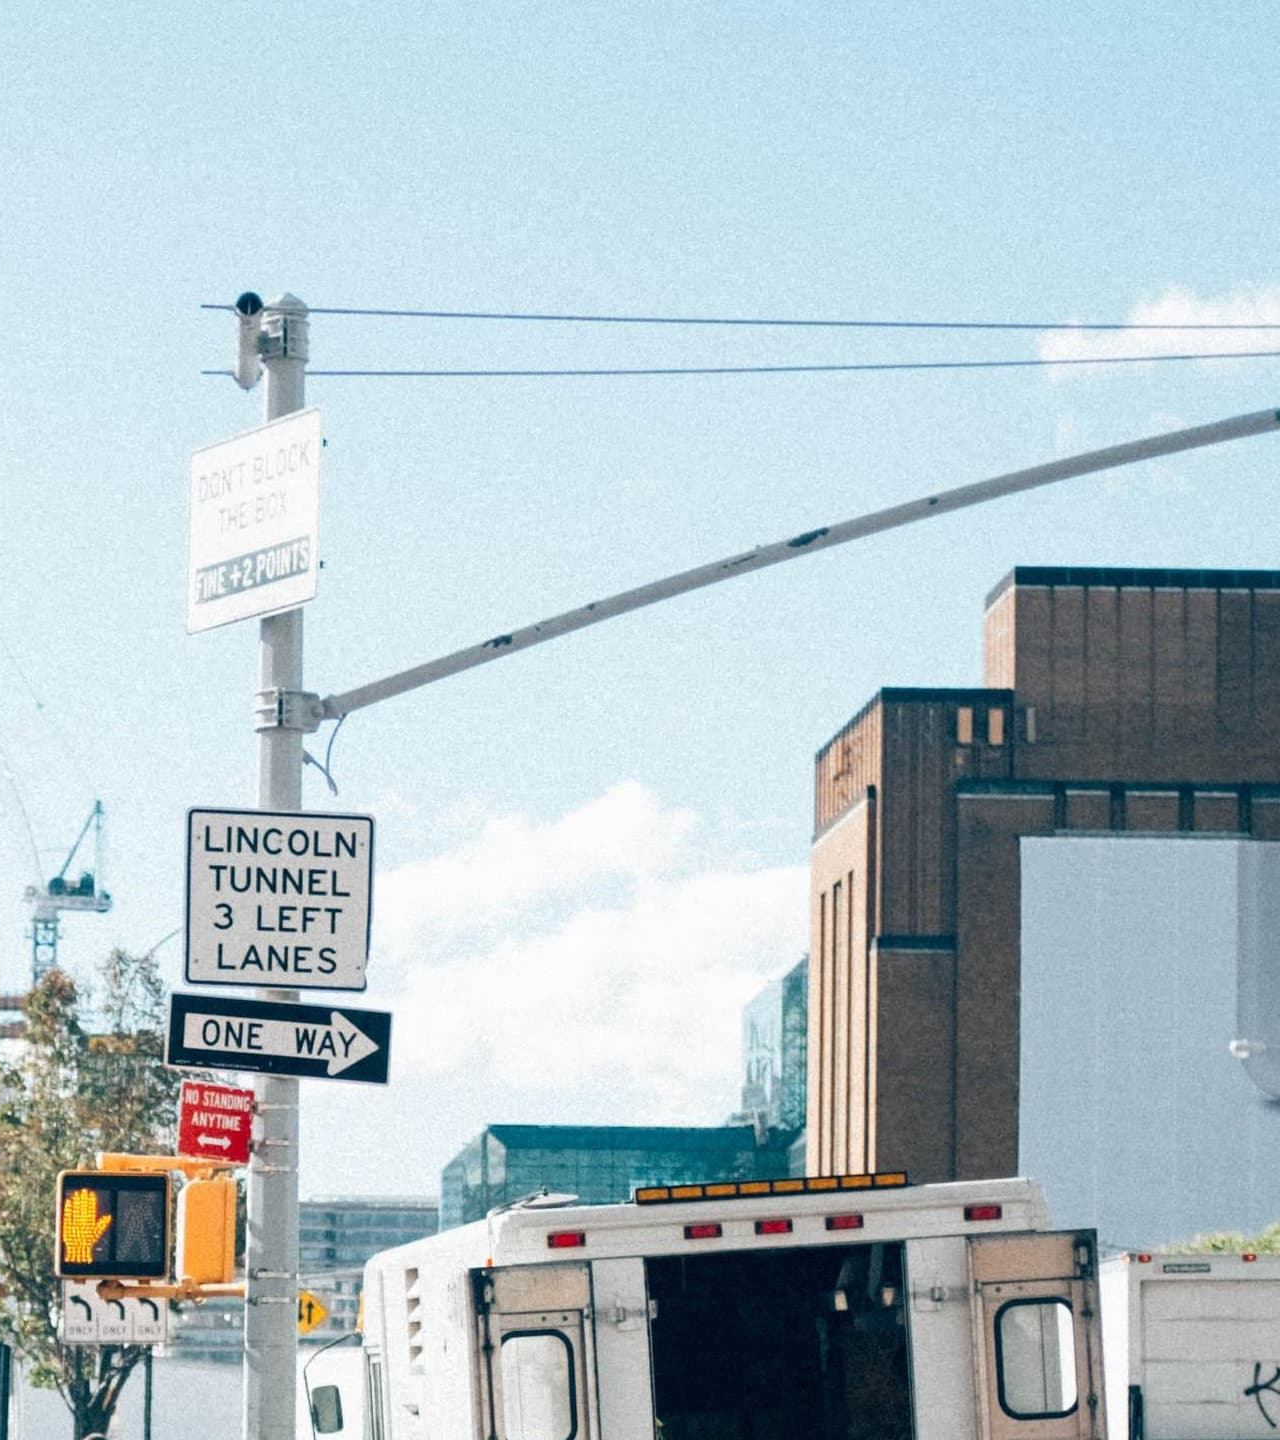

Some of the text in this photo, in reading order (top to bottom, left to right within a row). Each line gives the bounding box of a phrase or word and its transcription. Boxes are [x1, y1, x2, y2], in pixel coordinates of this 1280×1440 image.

[198, 439, 311, 502] DON'T BLOCK
[218, 489, 288, 534] THE BOX
[196, 565, 226, 602] FINE
[256, 540, 310, 583] POINTS
[204, 825, 358, 859] LINCOLN
[209, 864, 351, 898] TUNNEL
[213, 903, 343, 934] 3 LEFT
[217, 943, 337, 974] LANES
[201, 1019, 358, 1058] ONE WAY
[185, 1088, 251, 1112] NO STANDING
[191, 1111, 242, 1132] ANYTIME
[102, 1326, 127, 1335] ONLY
